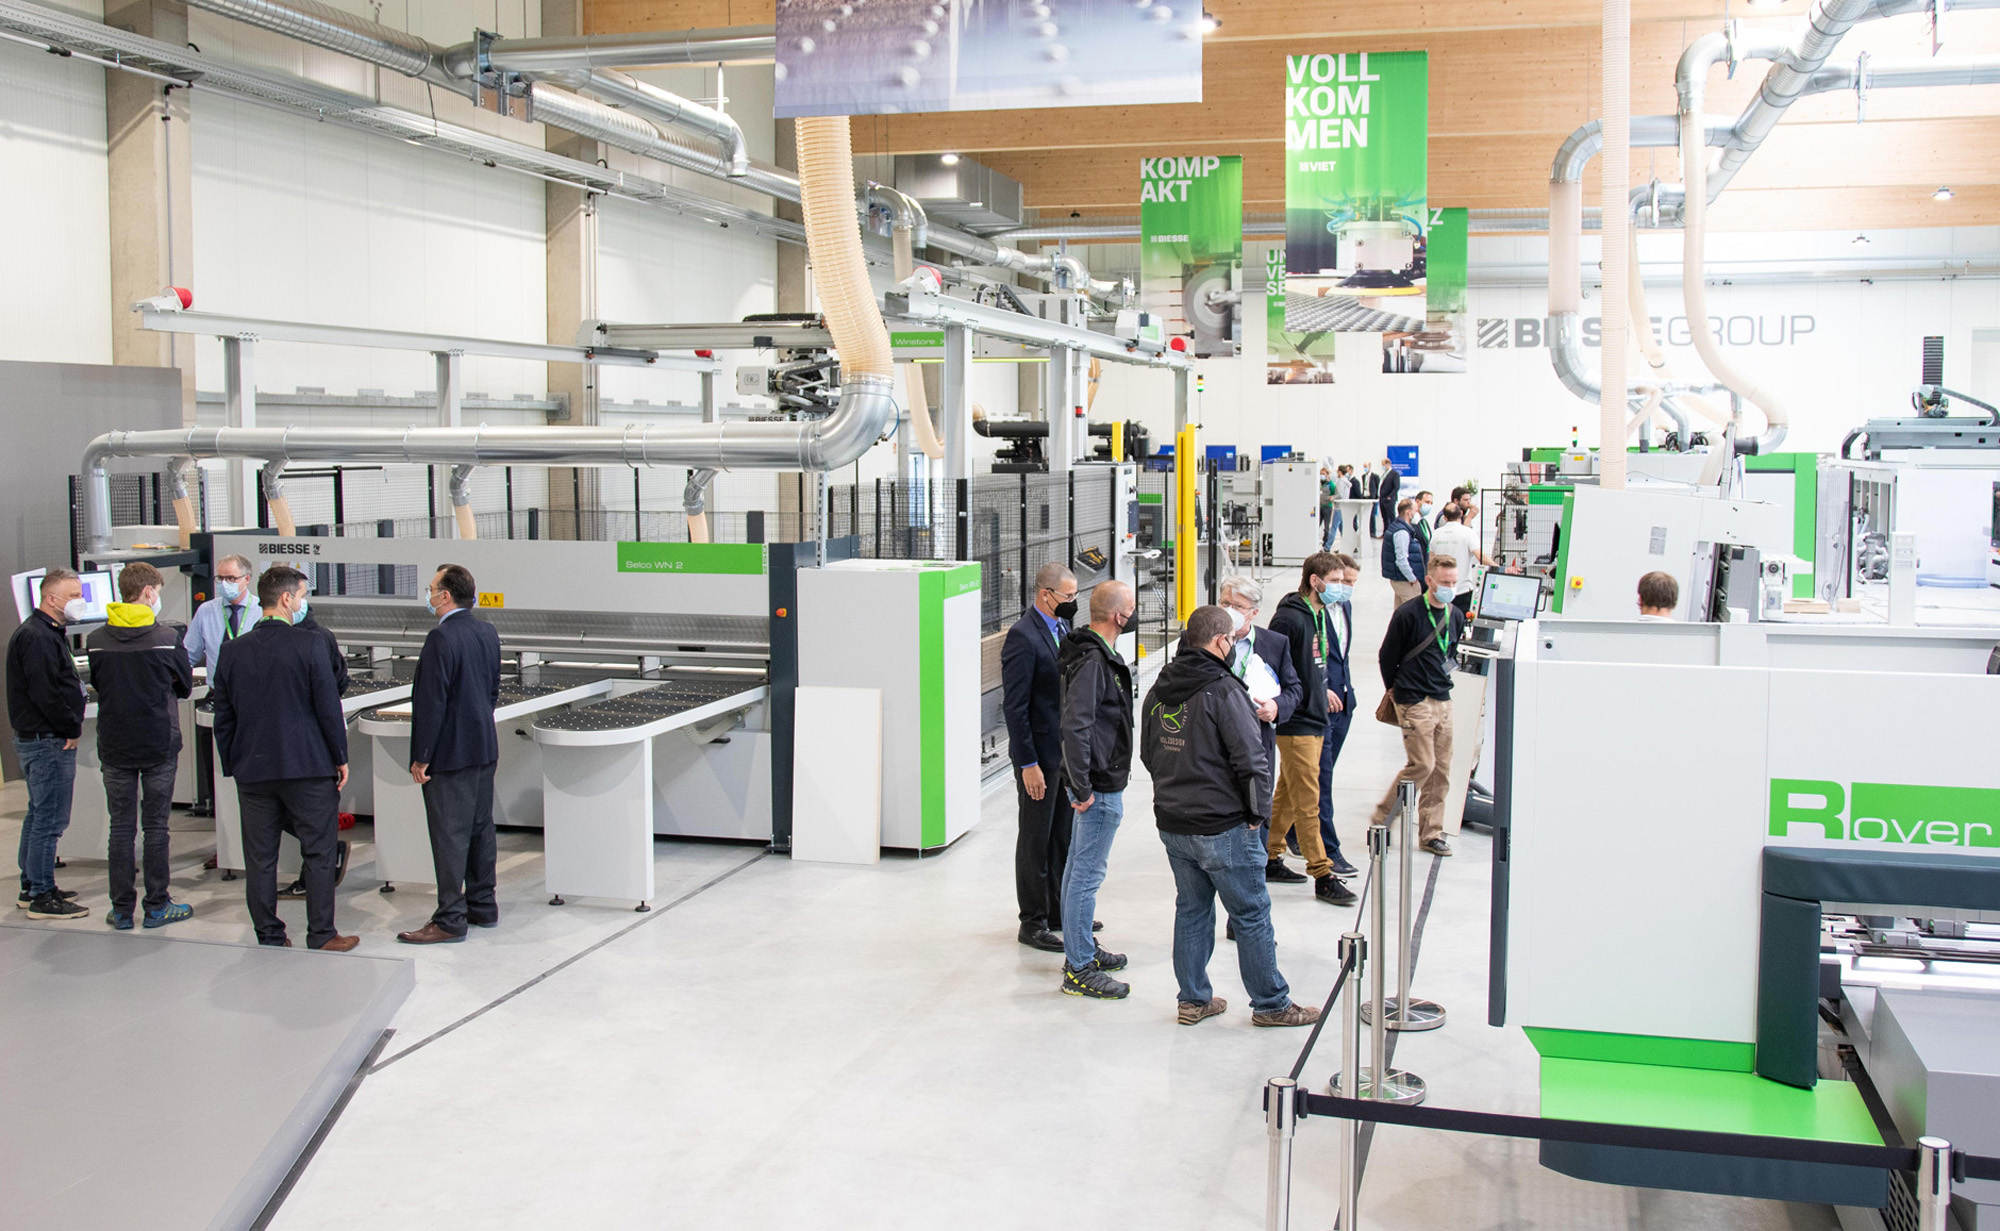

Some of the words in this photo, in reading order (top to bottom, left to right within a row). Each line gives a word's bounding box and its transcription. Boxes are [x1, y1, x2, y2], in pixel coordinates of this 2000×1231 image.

[1286, 52, 1380, 84] VOLL
[1285, 84, 1370, 116] KOM
[1285, 117, 1368, 151] MEN
[1140, 156, 1220, 179] KOMP
[1309, 161, 1336, 172] VIET
[1140, 180, 1193, 203] AKT
[1158, 234, 1189, 242] BIESSE
[895, 338, 936, 346] Winstore
[269, 543, 310, 555] BIESSE
[626, 561, 652, 569] Selco
[654, 561, 673, 569] WN
[675, 561, 684, 569] 2
[1768, 778, 1993, 847] Rover
